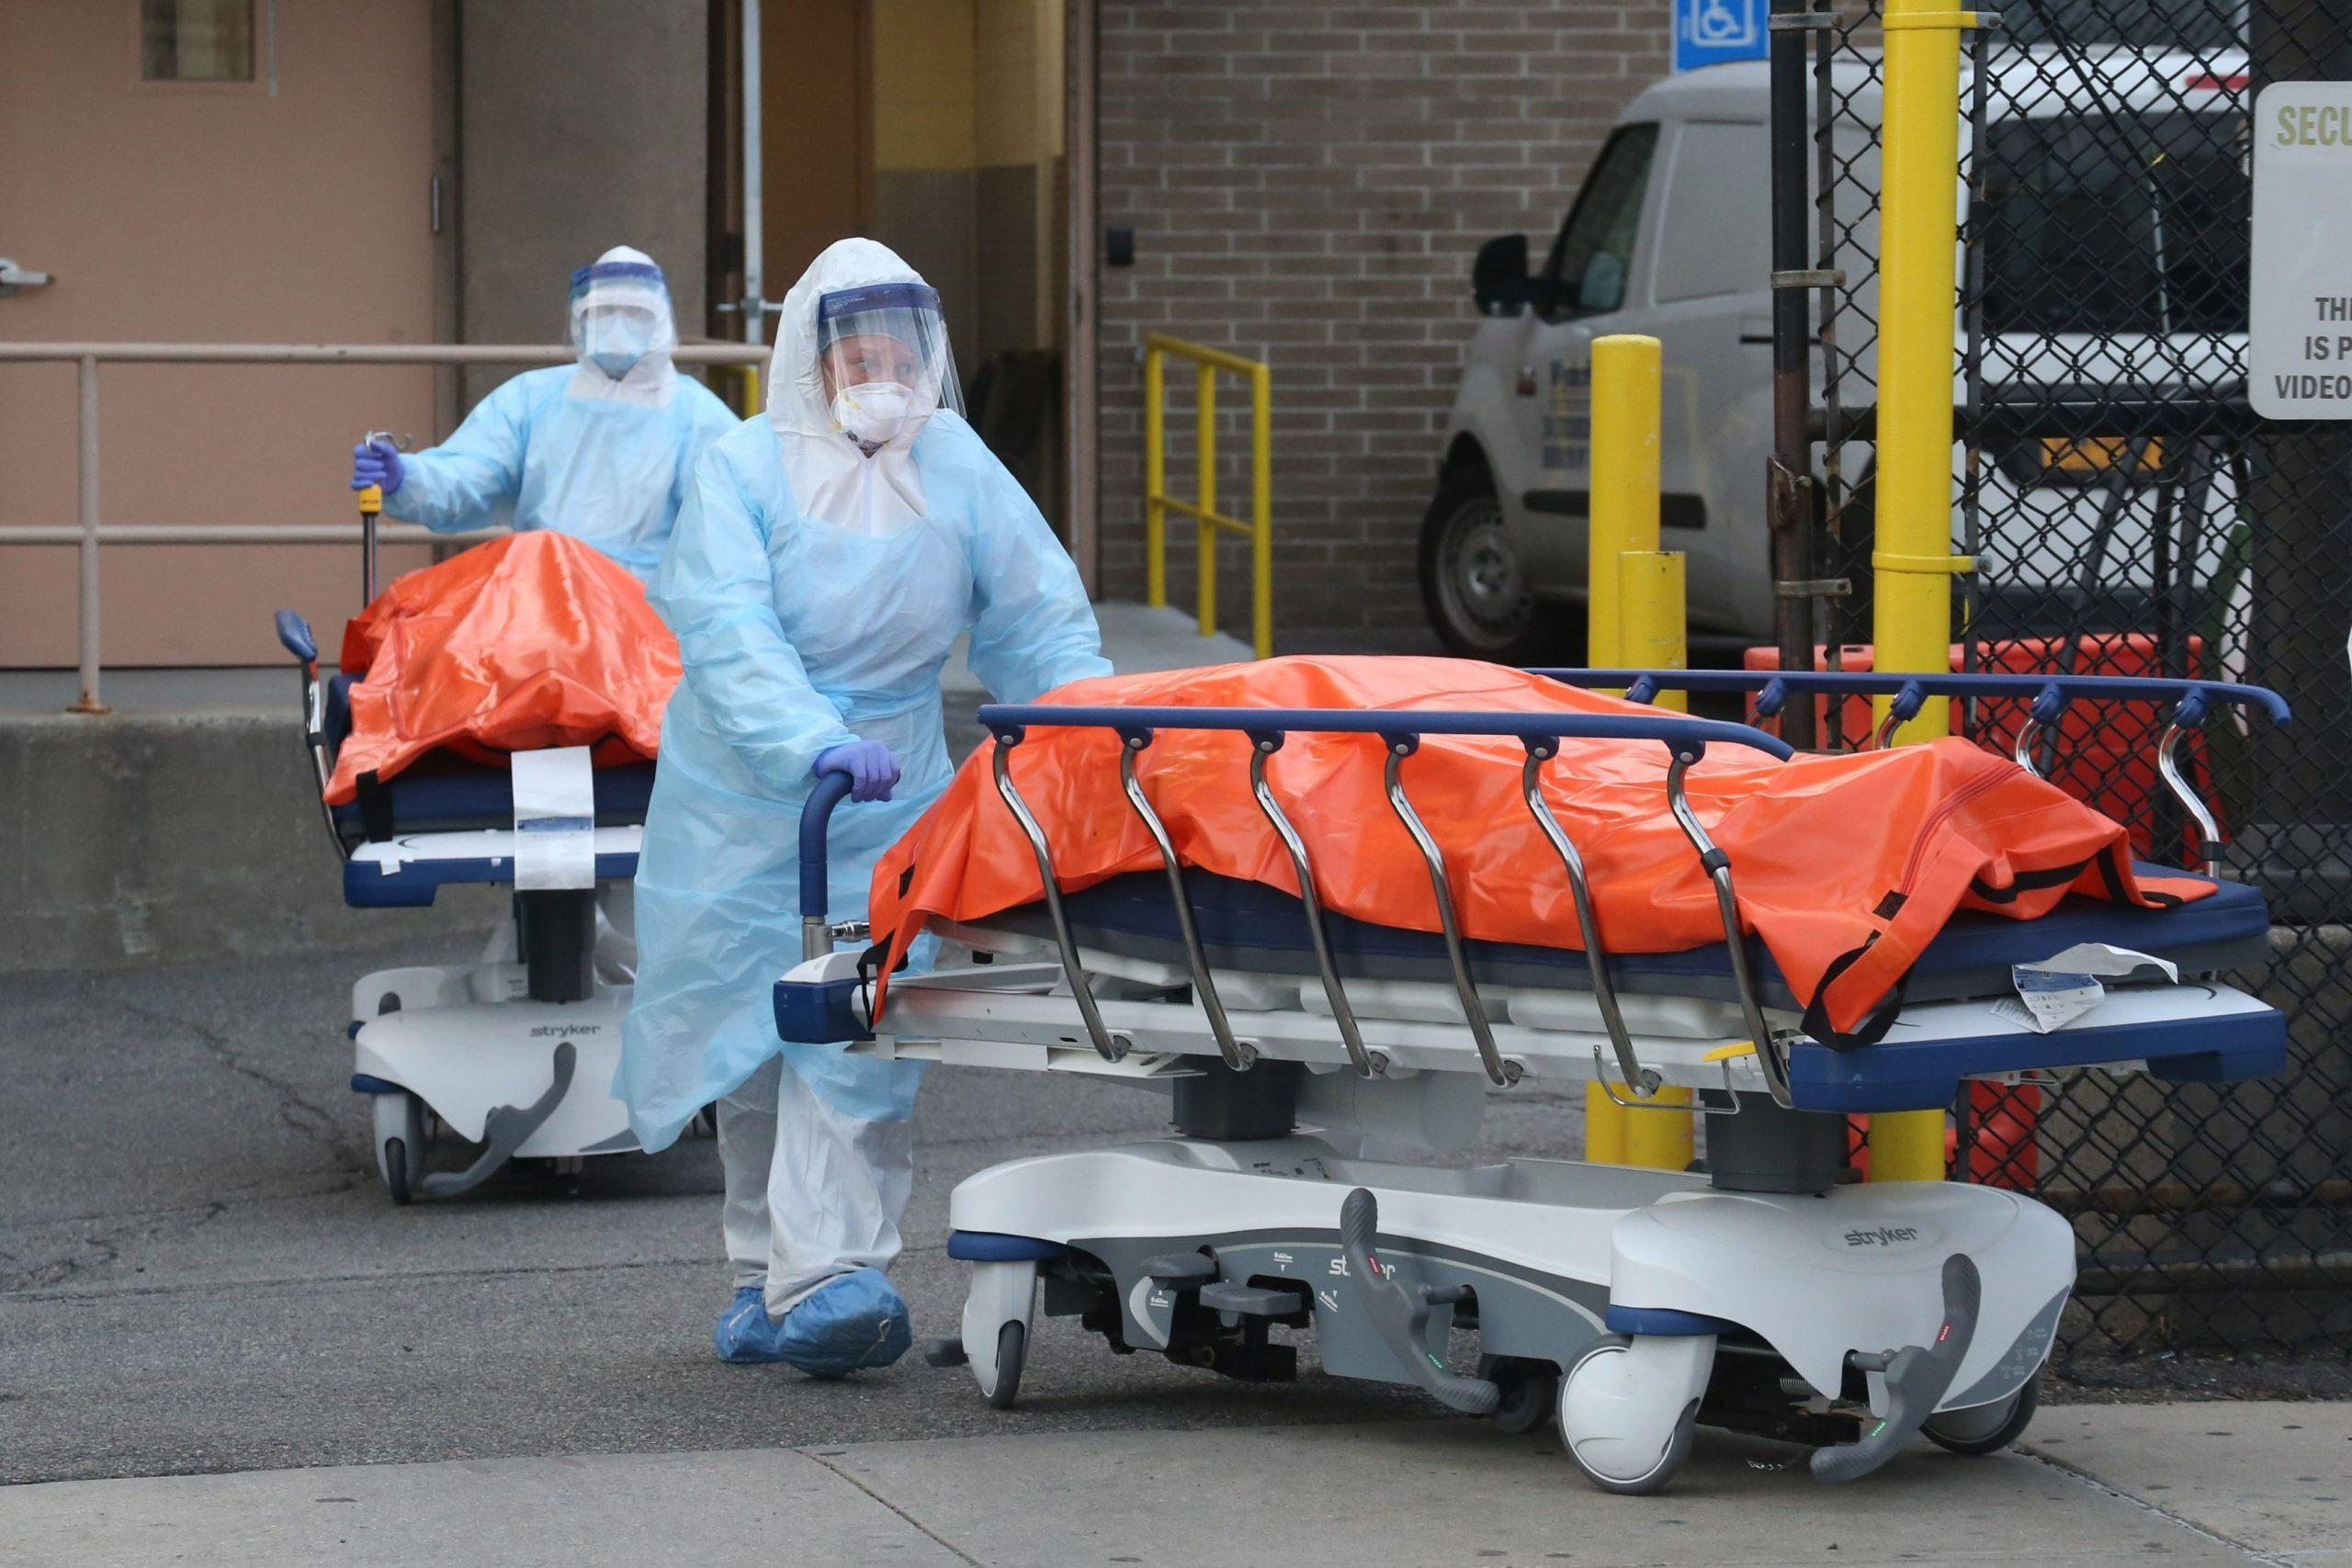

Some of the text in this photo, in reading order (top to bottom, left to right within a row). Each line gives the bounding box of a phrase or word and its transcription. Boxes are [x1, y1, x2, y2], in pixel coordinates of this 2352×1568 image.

[2305, 336, 2330, 360] IS
[2275, 375, 2352, 399] VIDEO
[529, 1023, 601, 1038] stryker
[1844, 1226, 1918, 1247] stryker
